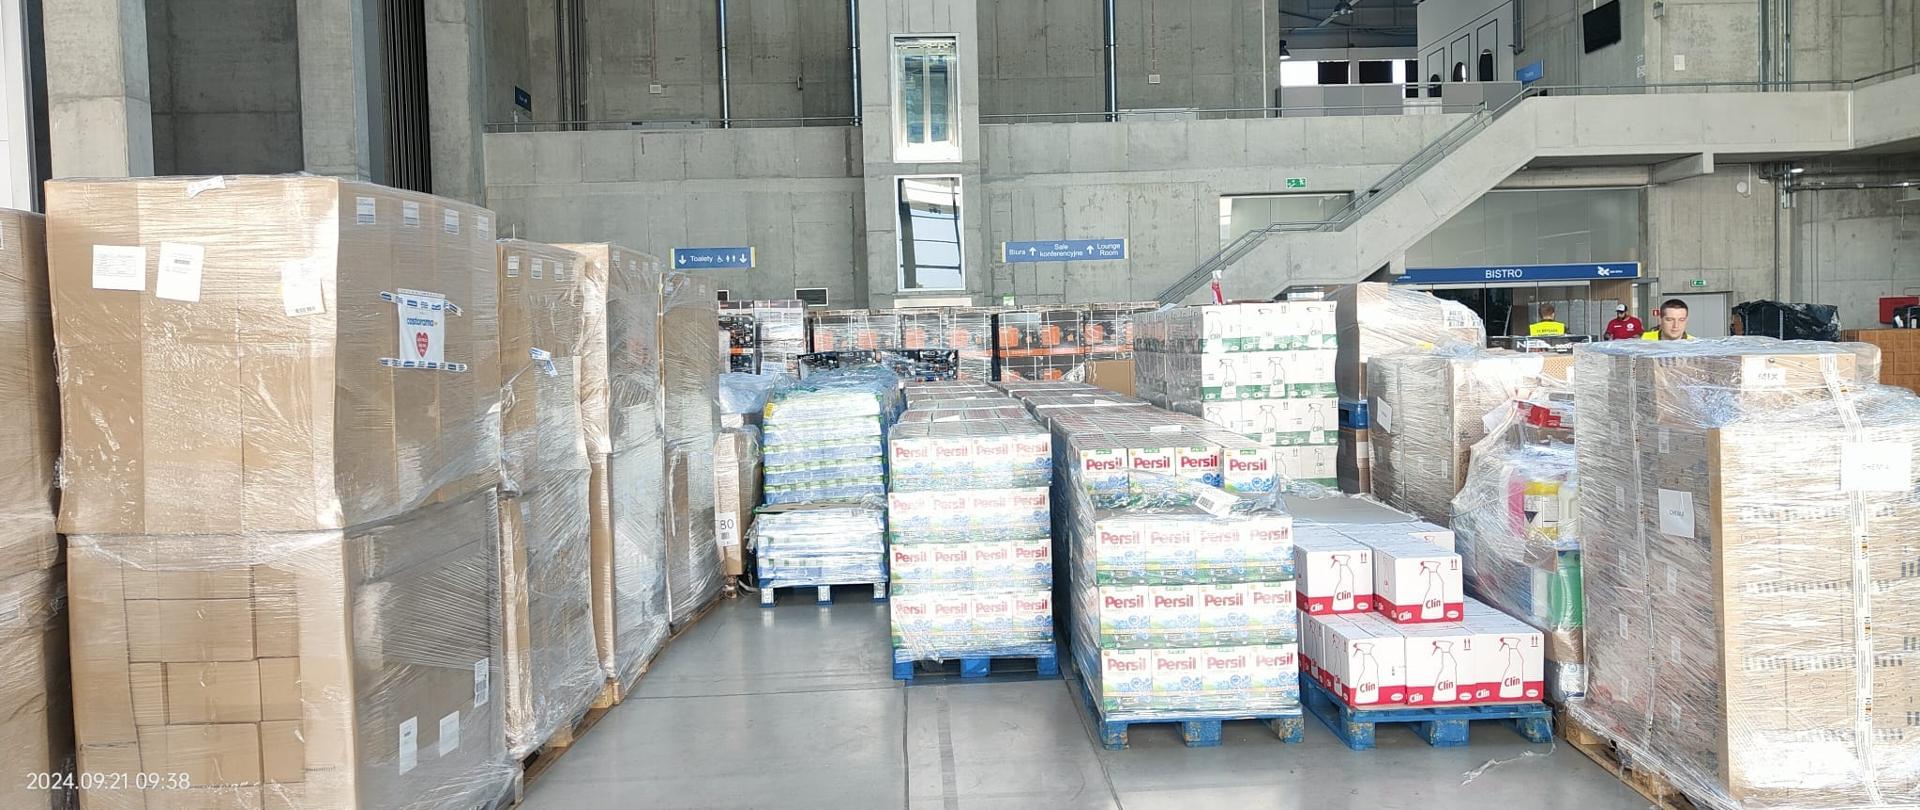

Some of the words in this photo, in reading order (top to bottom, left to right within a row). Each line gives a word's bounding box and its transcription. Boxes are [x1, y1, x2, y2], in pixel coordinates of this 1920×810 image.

[689, 255, 714, 263] Toalety
[1039, 249, 1084, 258] konferencyjne
[1485, 268, 1523, 279] BISTRO
[406, 317, 434, 327] castorama
[895, 446, 928, 458] Persil
[936, 446, 968, 457] Persil
[976, 444, 1008, 456] Persil
[1016, 442, 1048, 453] Persil
[1086, 456, 1122, 470] Persil
[1134, 455, 1170, 469] Persil
[1180, 454, 1217, 468] Persil
[1229, 457, 1267, 471] Persil
[973, 497, 1006, 508] Persil
[1014, 494, 1046, 506] Persil
[1101, 530, 1140, 544] Persil
[1151, 530, 1190, 544] Persil
[1250, 526, 1289, 541] Persil
[895, 551, 927, 562] Persil
[935, 550, 967, 562] Persil
[976, 549, 1008, 560] Persil
[1016, 546, 1048, 558] Persil
[1154, 594, 1194, 608] Persil
[1204, 592, 1244, 607] Persil
[1253, 590, 1292, 604] Persil
[1336, 589, 1352, 601] Clin
[976, 601, 1008, 613] Persil
[1016, 599, 1048, 611] Persil
[1105, 594, 1144, 609] Persil
[1425, 598, 1441, 609] Clin
[896, 602, 927, 614] Persil
[935, 602, 967, 614] Persil
[1398, 610, 1413, 621] Clin
[1107, 656, 1147, 671] Persil
[1157, 656, 1196, 670] Persil
[1206, 655, 1246, 669] Persil
[1255, 652, 1294, 667] Persil
[1359, 681, 1376, 693] Clin
[1437, 680, 1454, 691] Clin
[1503, 675, 1521, 688] Clin
[1408, 693, 1424, 703] Clin
